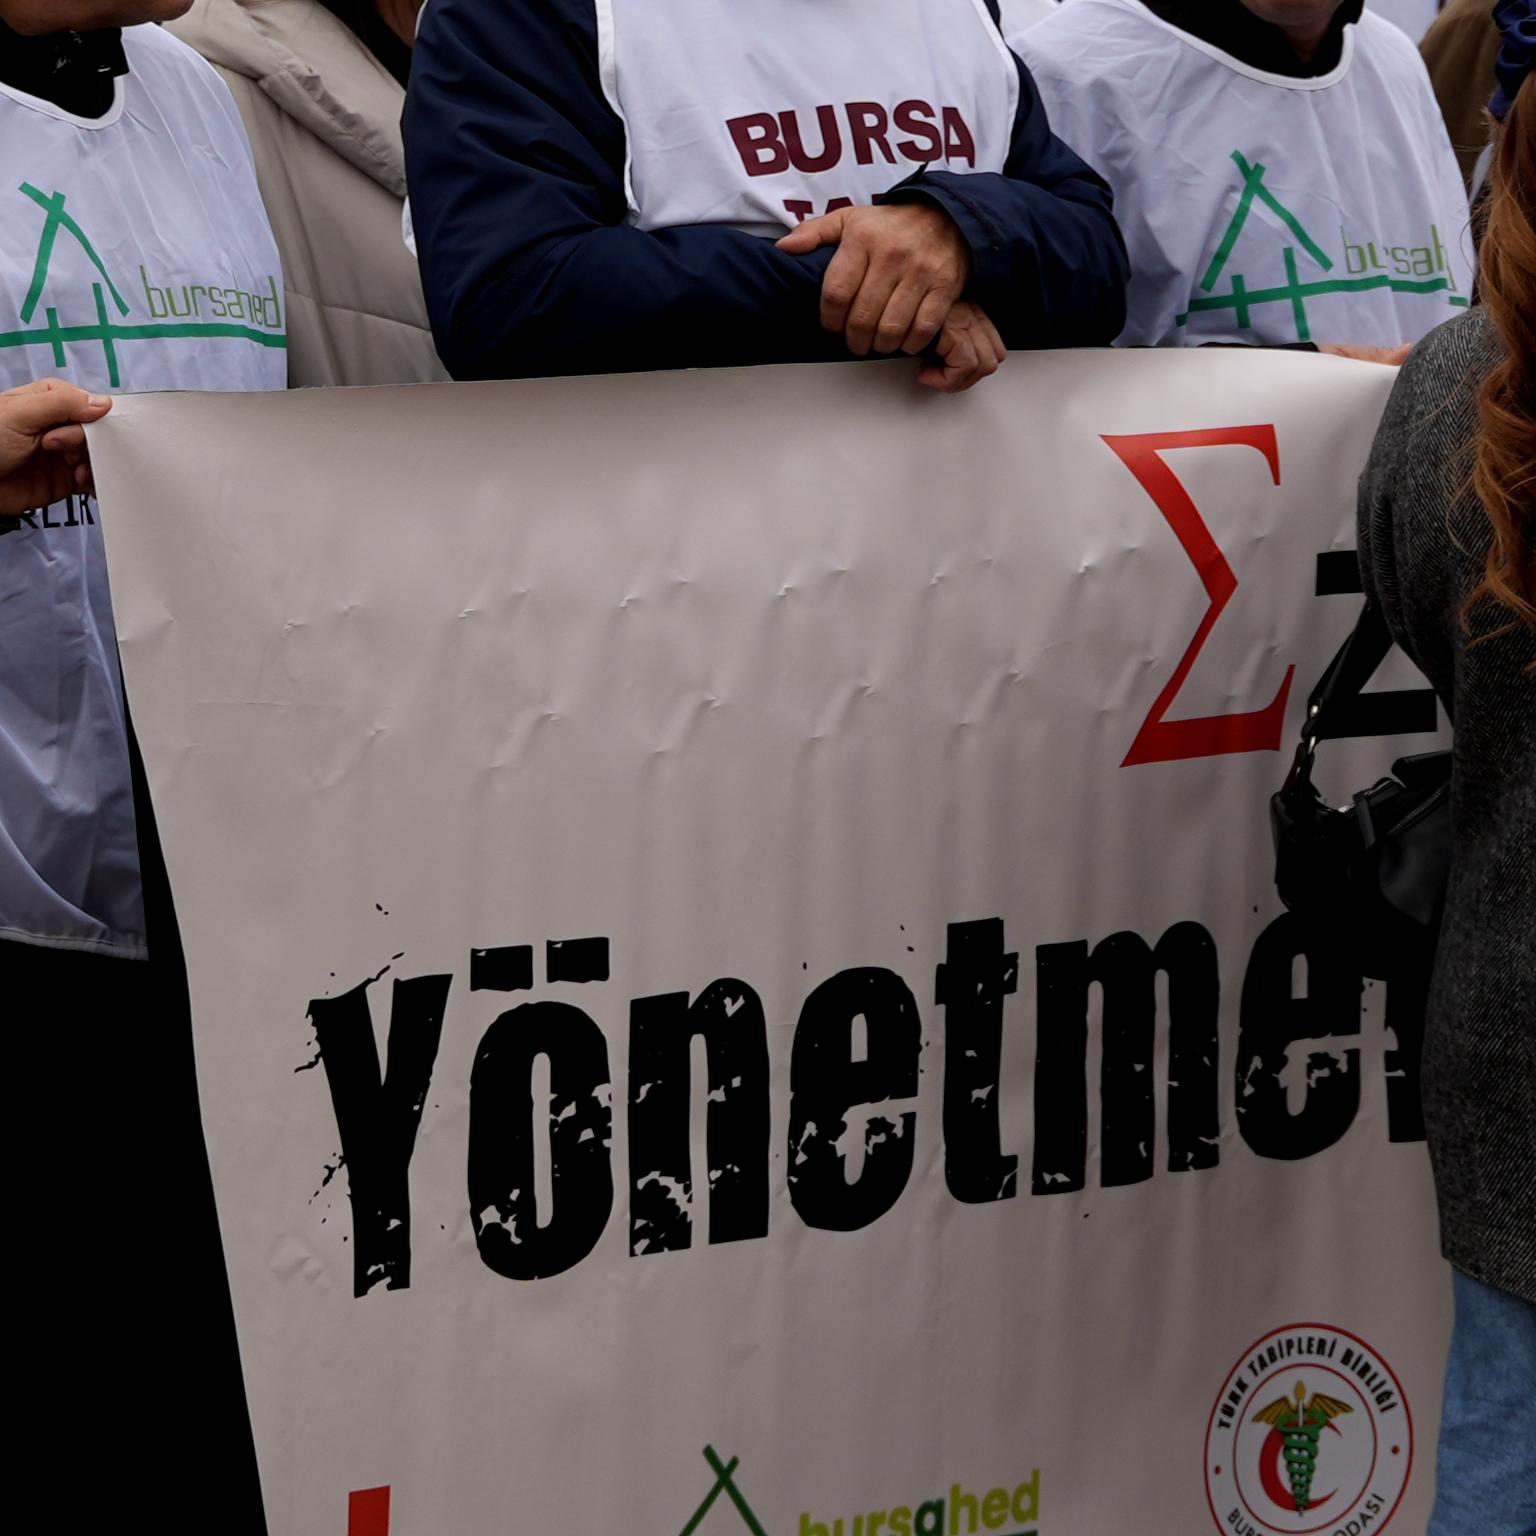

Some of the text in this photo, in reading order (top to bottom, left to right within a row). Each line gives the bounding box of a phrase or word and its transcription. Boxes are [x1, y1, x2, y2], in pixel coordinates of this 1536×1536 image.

[726, 99, 976, 177] BURSA
[1217, 1336, 1398, 1429] TÜRK TABİPLERİ BİRLİĞİ
